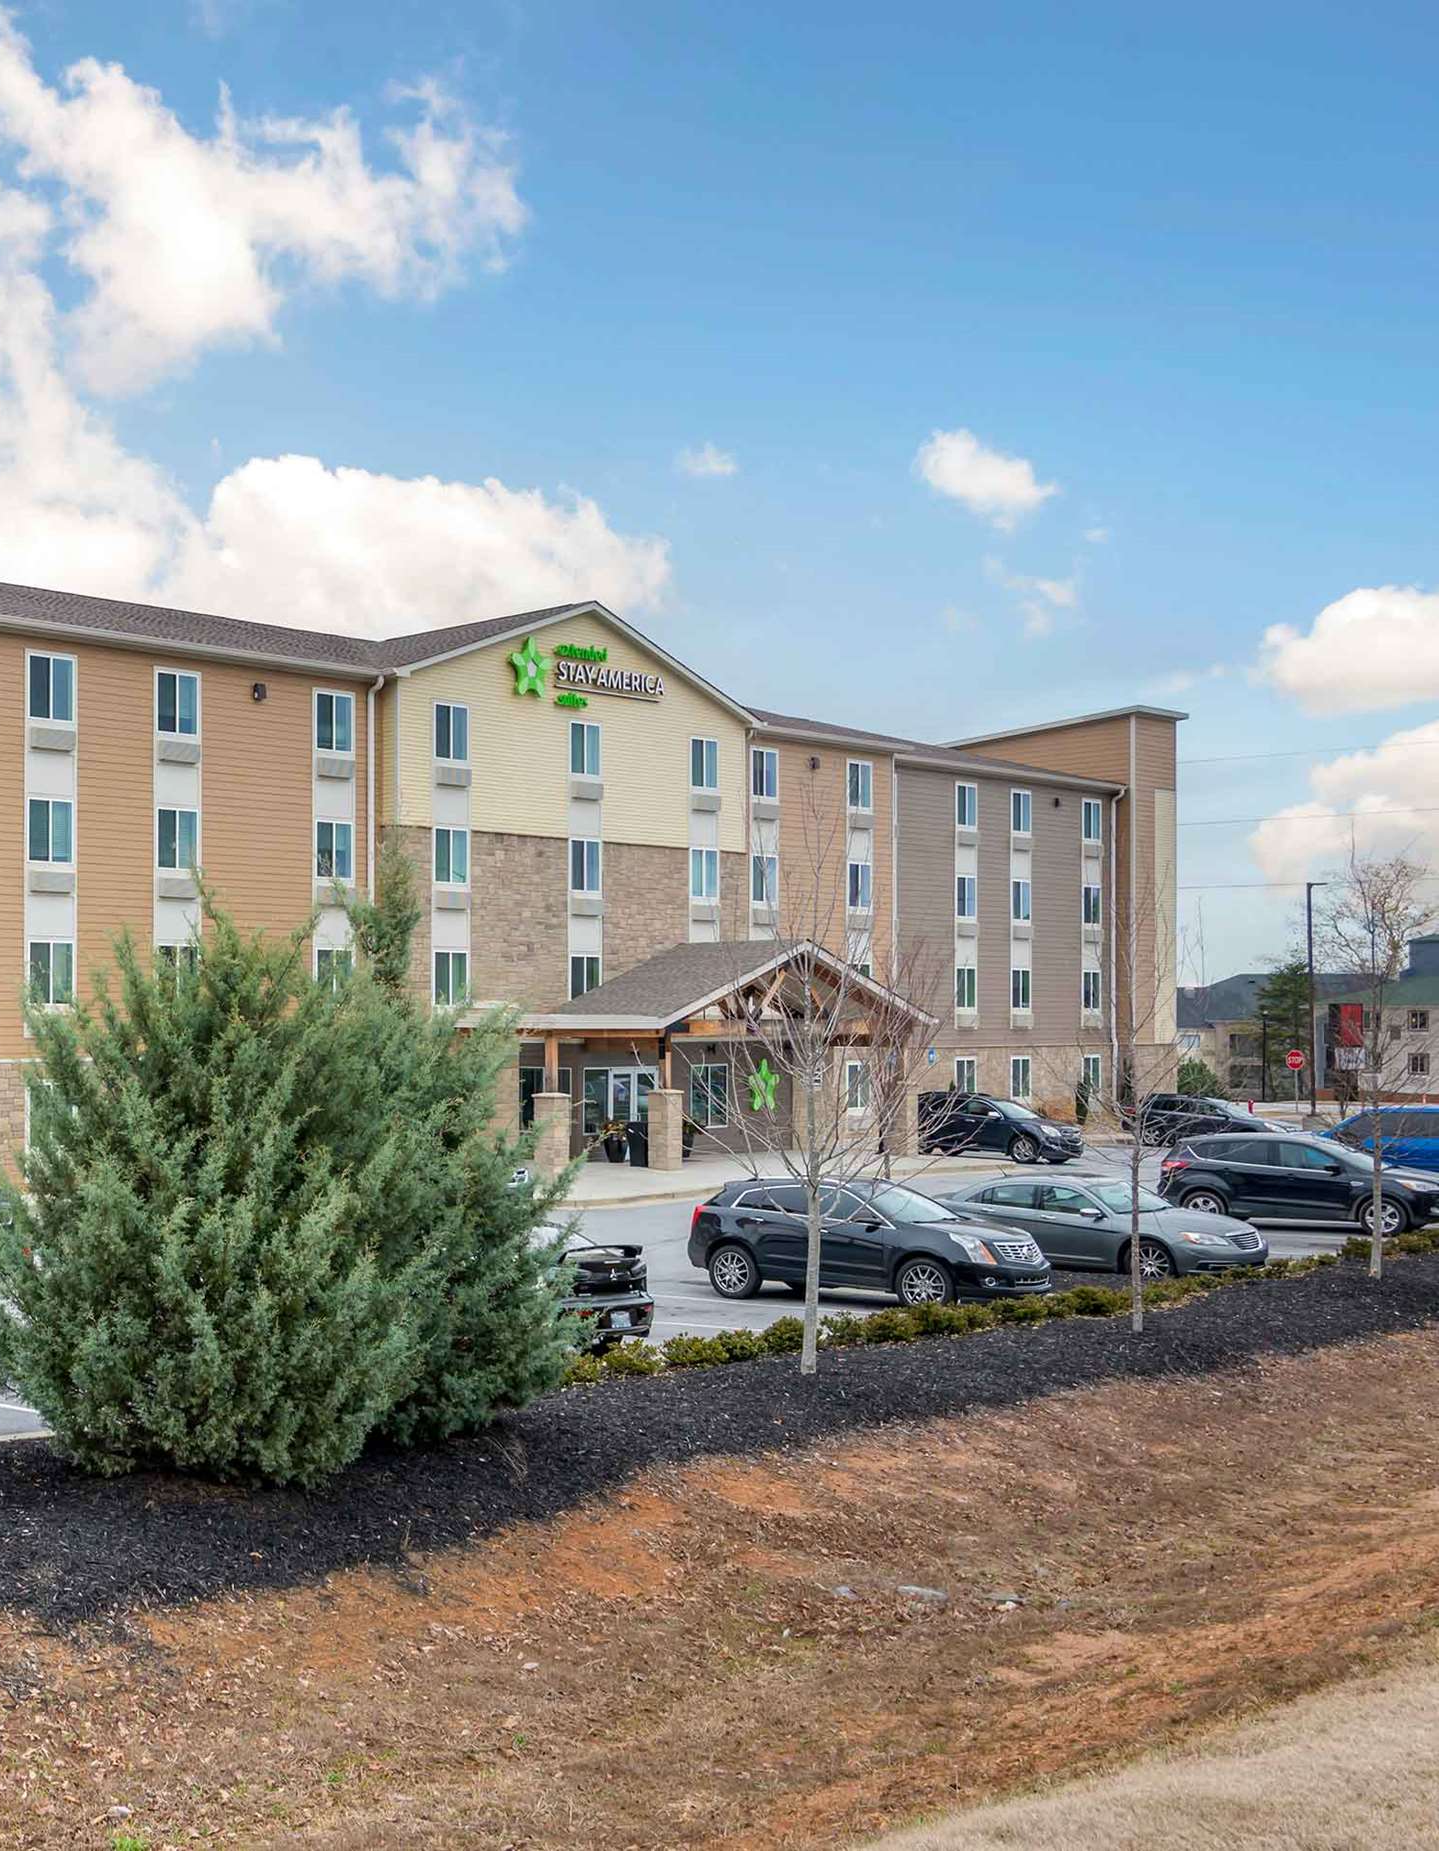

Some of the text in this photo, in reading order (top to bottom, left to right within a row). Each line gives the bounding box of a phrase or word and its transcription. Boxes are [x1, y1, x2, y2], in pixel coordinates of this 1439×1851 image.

[558, 660, 665, 695] STAY AMERICA
[1287, 1056, 1305, 1065] STOP
